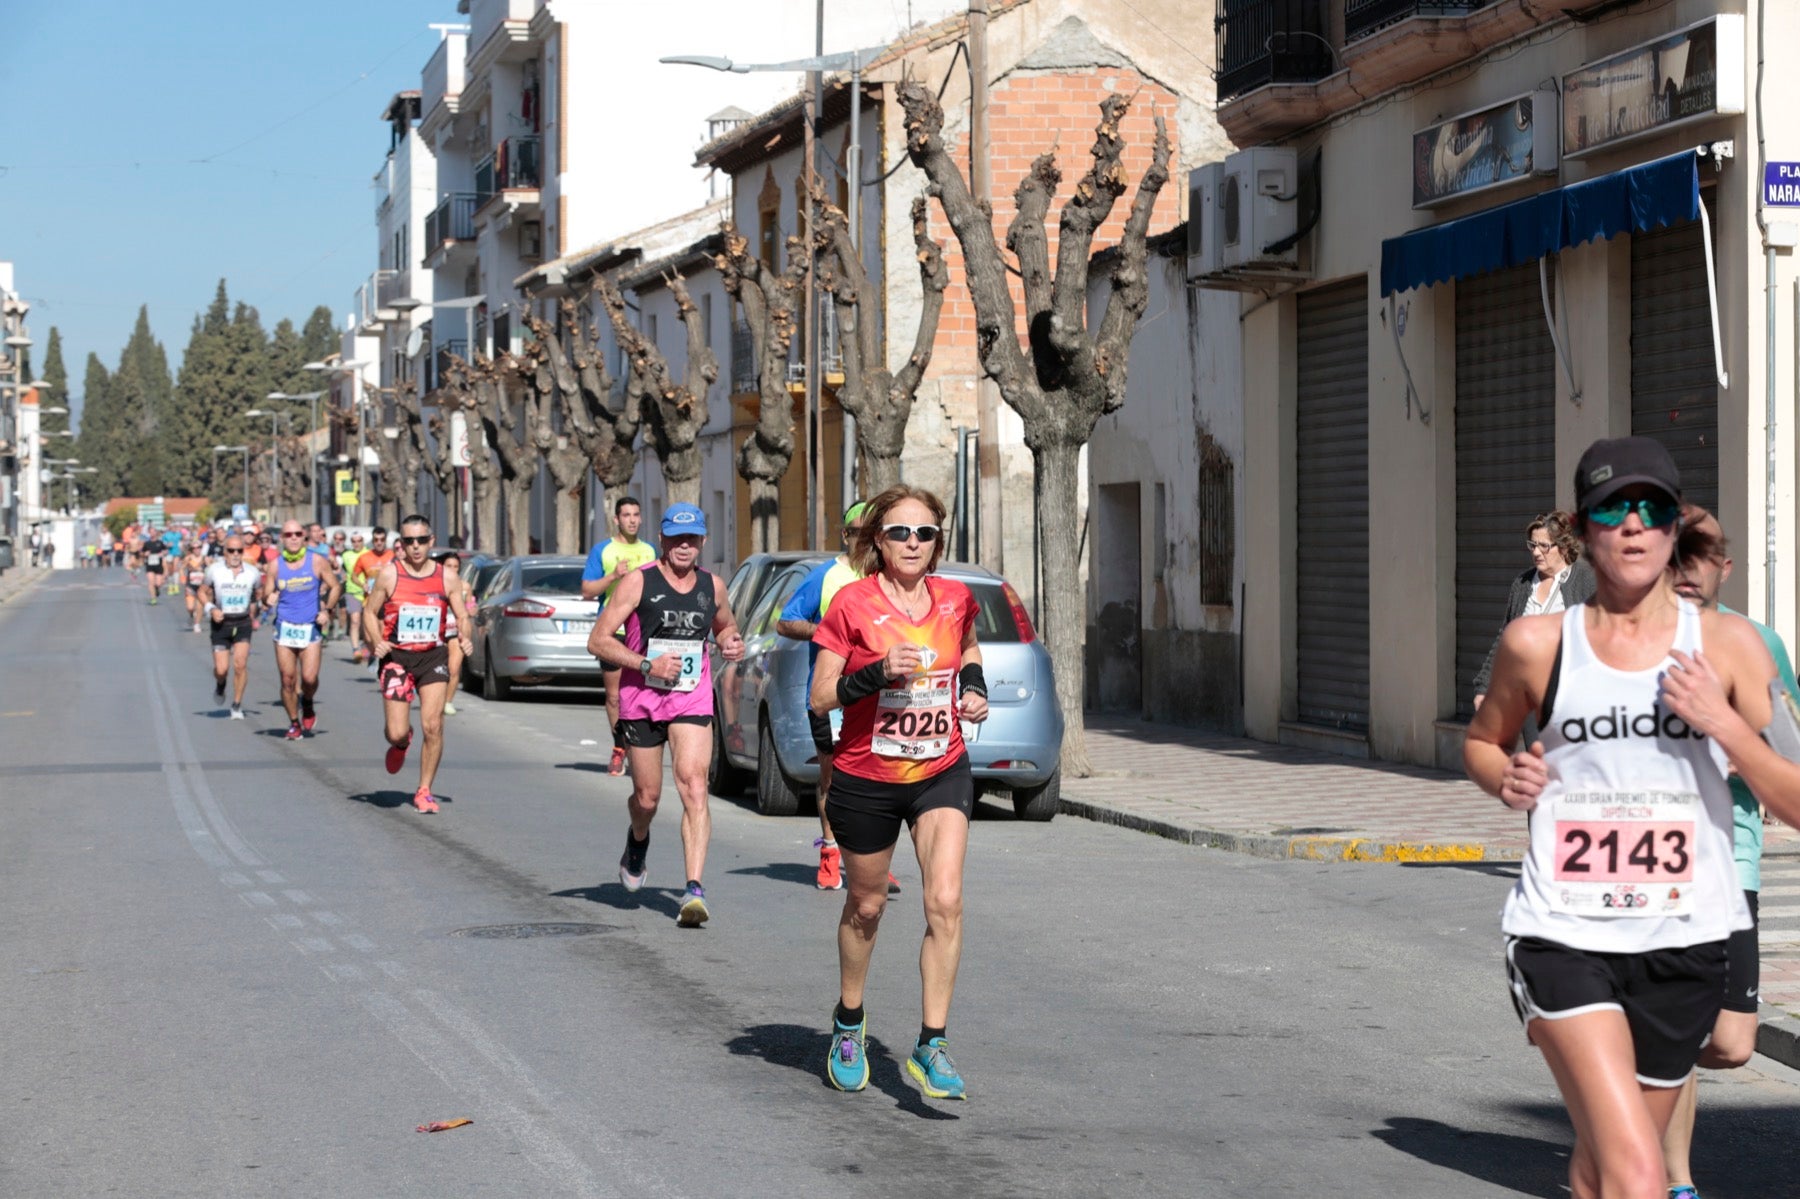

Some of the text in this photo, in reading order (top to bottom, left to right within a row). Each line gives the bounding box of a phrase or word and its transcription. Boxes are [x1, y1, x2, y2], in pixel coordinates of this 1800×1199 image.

[1680, 90, 1712, 114] DETALLES
[1588, 118, 1601, 143] de
[1769, 184, 1800, 202] NARA
[286, 628, 306, 639] 453
[406, 616, 434, 630] 417
[878, 709, 949, 737] 2026
[1589, 791, 1613, 804] GRAN
[1615, 791, 1646, 804] PREMIO
[1562, 829, 1689, 874] 2143
